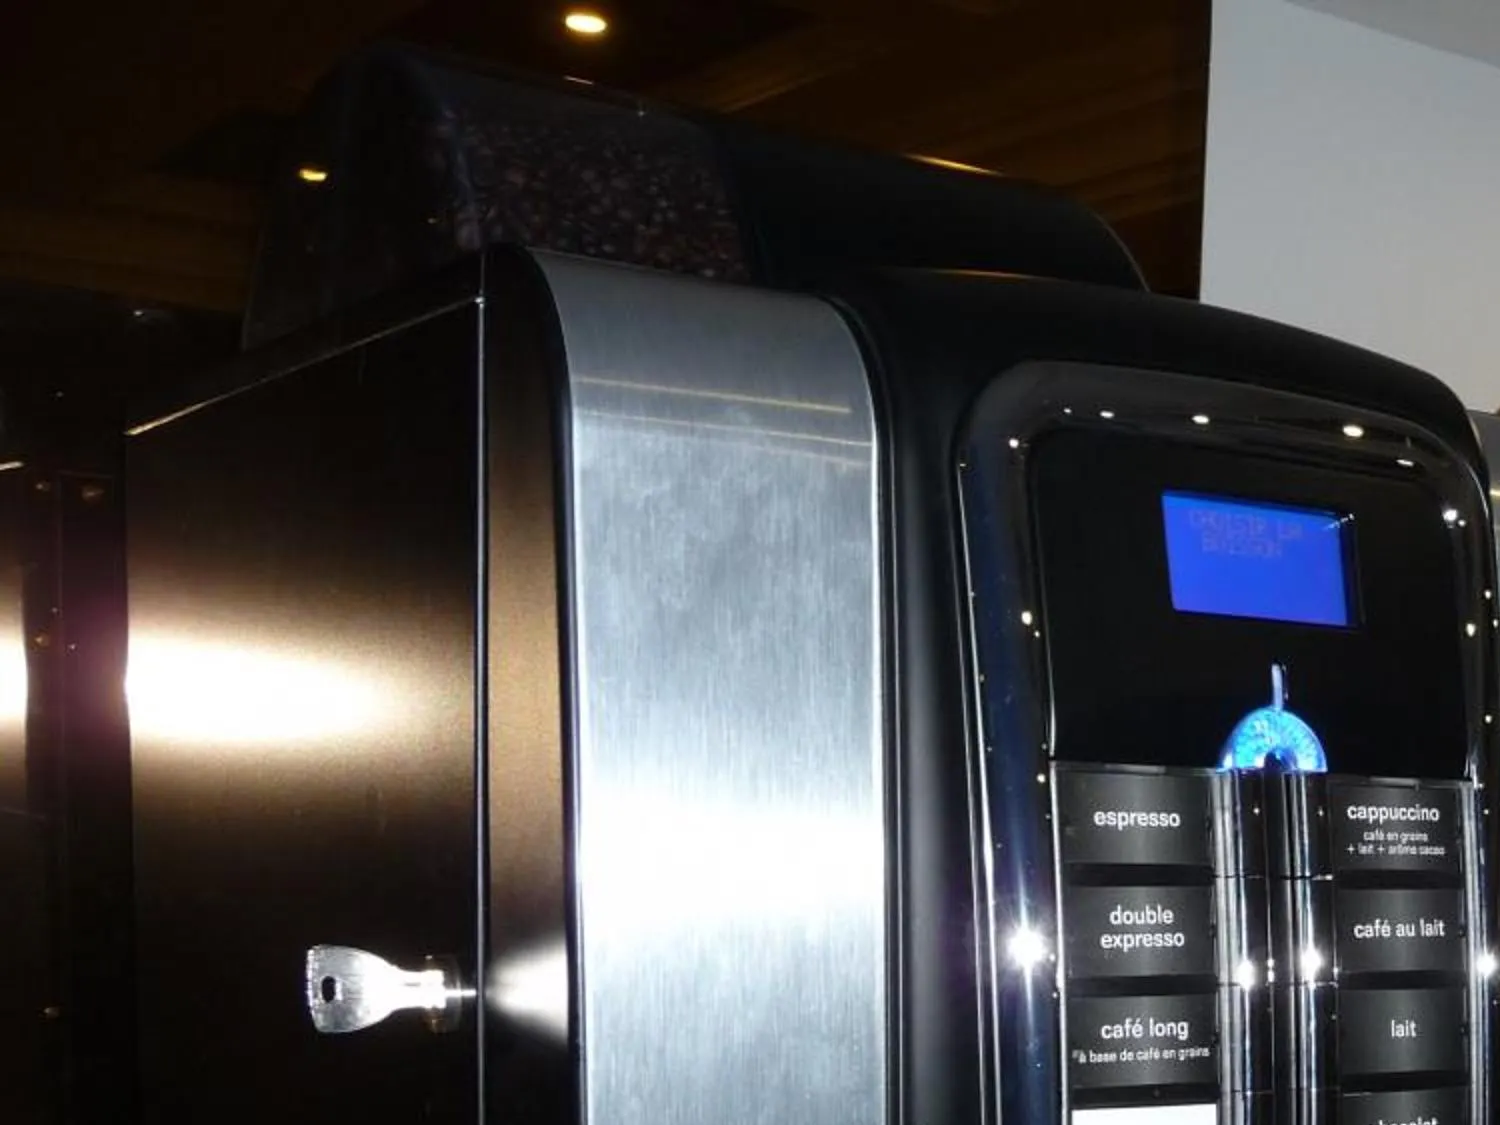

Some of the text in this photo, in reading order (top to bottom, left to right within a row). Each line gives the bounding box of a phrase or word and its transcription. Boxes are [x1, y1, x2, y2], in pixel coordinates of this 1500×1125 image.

[1093, 810, 1181, 831] espresso
[1347, 803, 1440, 824] cappuccino
[1386, 832, 1398, 841] en
[1109, 904, 1174, 925] double
[1353, 917, 1446, 938] café au lait
[1101, 932, 1185, 952] expresso
[1100, 1016, 1190, 1041] café long
[1390, 1018, 1417, 1038] lait
[1089, 1048, 1118, 1063] base
[1119, 1047, 1133, 1062] de
[1135, 1046, 1160, 1061] café
[1162, 1049, 1176, 1060] en
